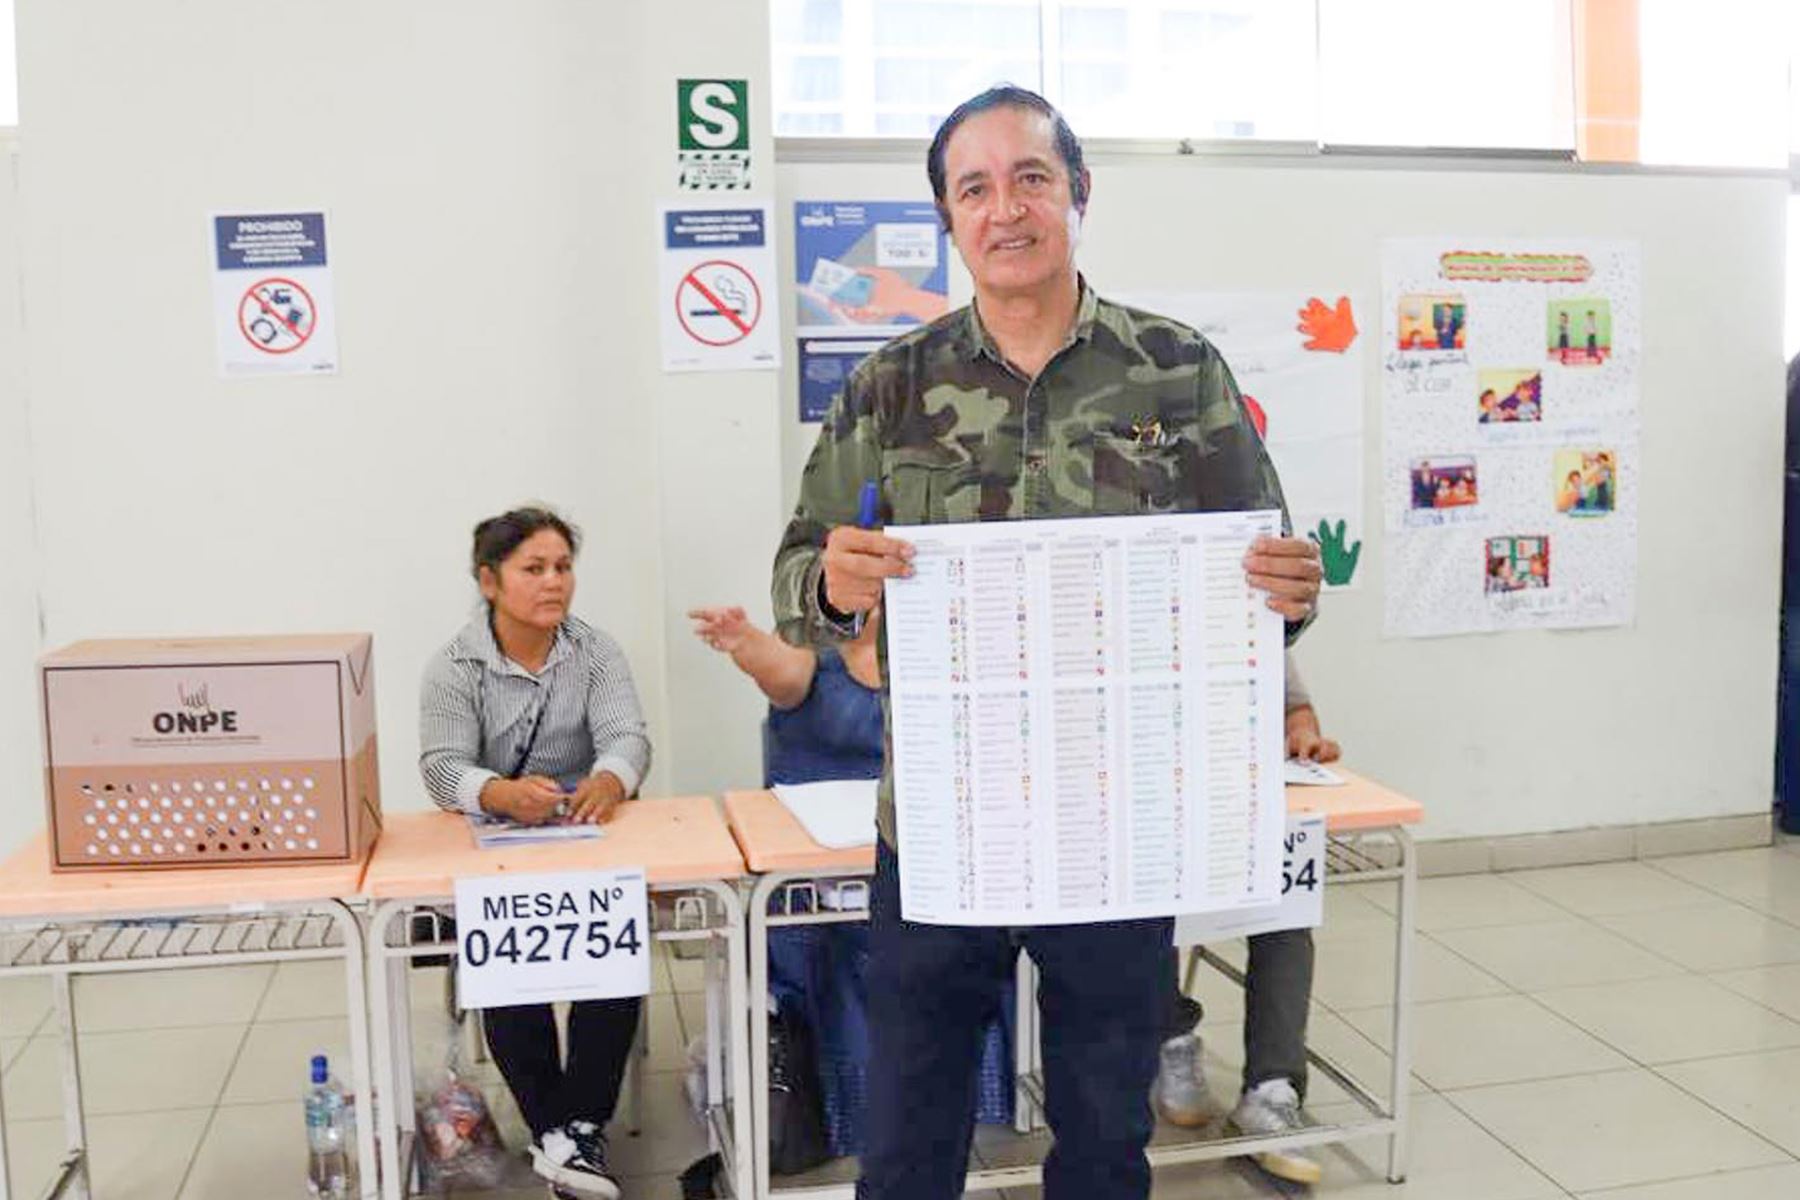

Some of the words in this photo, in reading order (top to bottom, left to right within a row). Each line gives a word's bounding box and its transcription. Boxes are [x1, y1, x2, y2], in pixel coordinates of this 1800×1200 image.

[689, 82, 739, 148] S
[153, 710, 238, 734] ONPE
[483, 892, 579, 921] MESA
[465, 918, 642, 967] 042754
